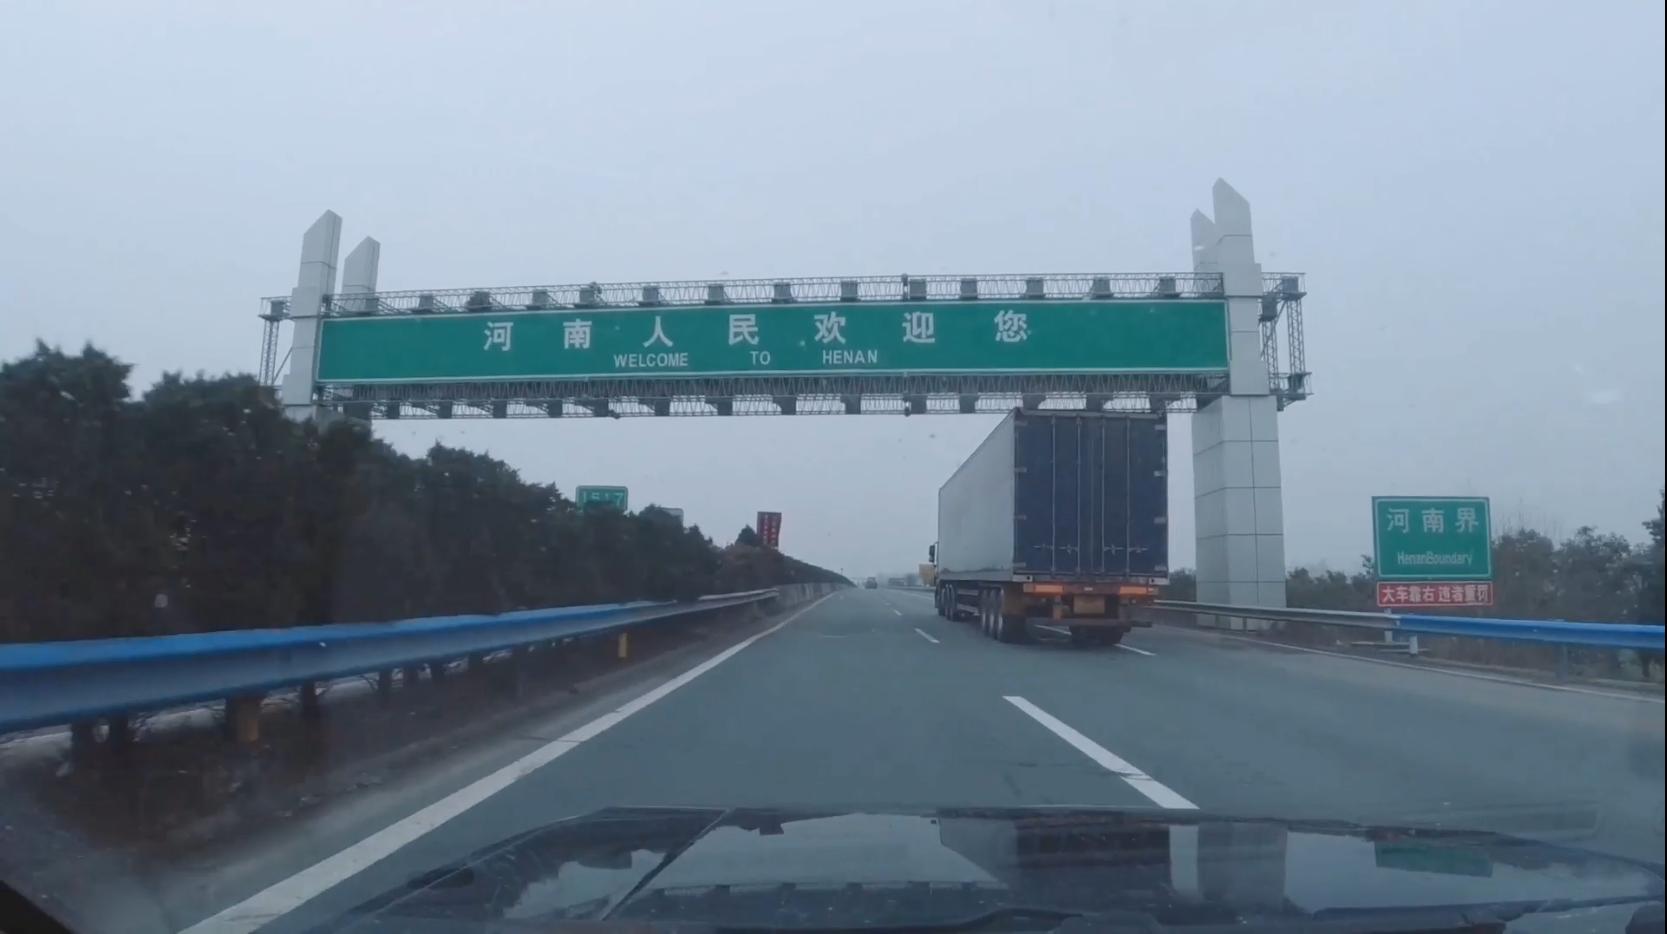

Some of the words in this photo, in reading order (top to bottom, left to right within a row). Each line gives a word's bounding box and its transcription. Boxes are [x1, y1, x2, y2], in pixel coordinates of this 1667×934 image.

[483, 311, 1029, 352] 河南人民欢迎您
[613, 352, 689, 369] WELCOME
[750, 350, 771, 366] TO
[822, 349, 878, 365] HENAN
[1386, 507, 1479, 533] 河南界
